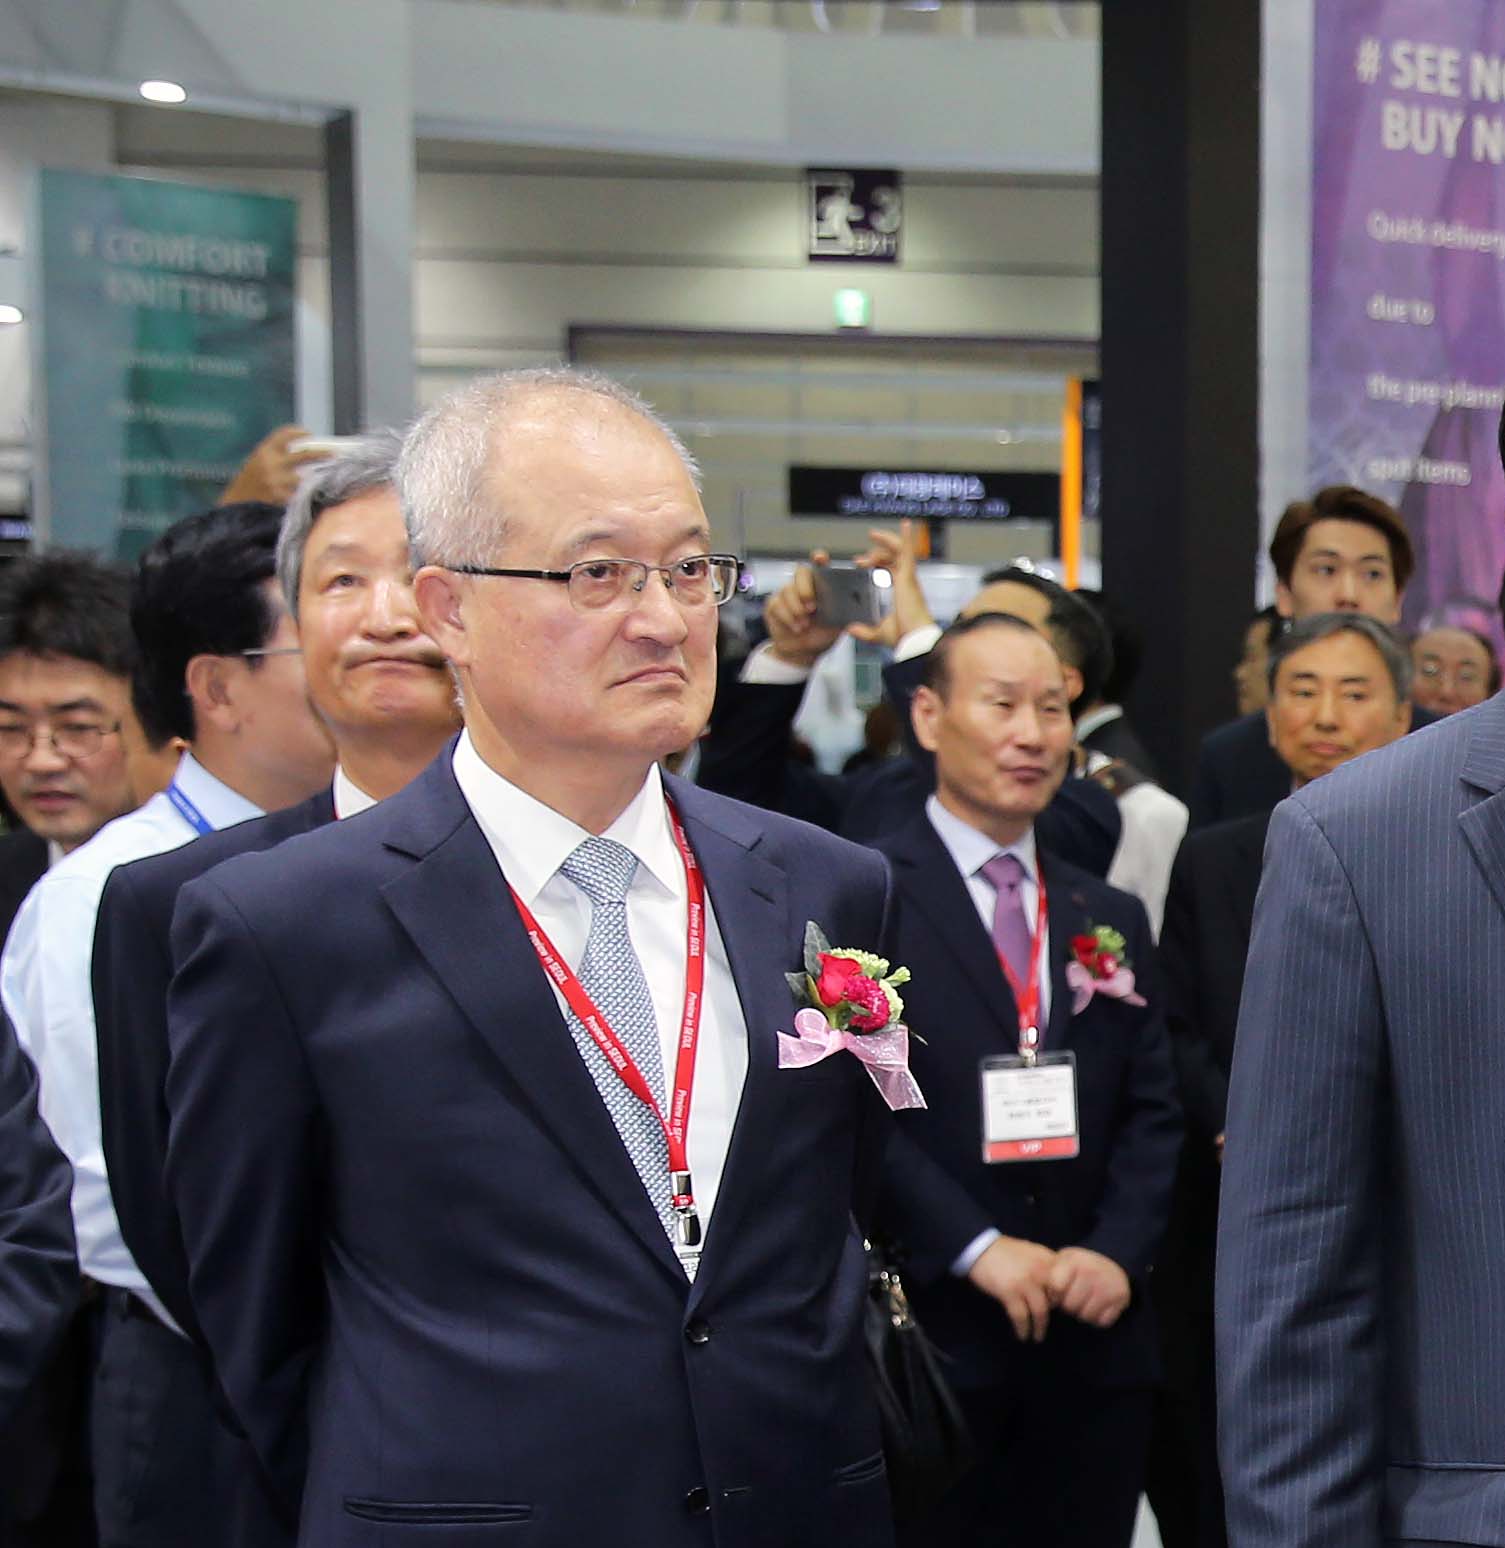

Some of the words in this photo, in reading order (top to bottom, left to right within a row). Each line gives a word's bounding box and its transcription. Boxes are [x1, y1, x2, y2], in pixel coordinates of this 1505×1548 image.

[1389, 40, 1461, 98] SEE
[1383, 99, 1465, 159] BUY
[1367, 211, 1425, 243] Quick
[103, 231, 271, 277] COMFORT
[106, 272, 269, 319] KNITTING
[1367, 294, 1407, 323] due
[1367, 374, 1400, 400] the
